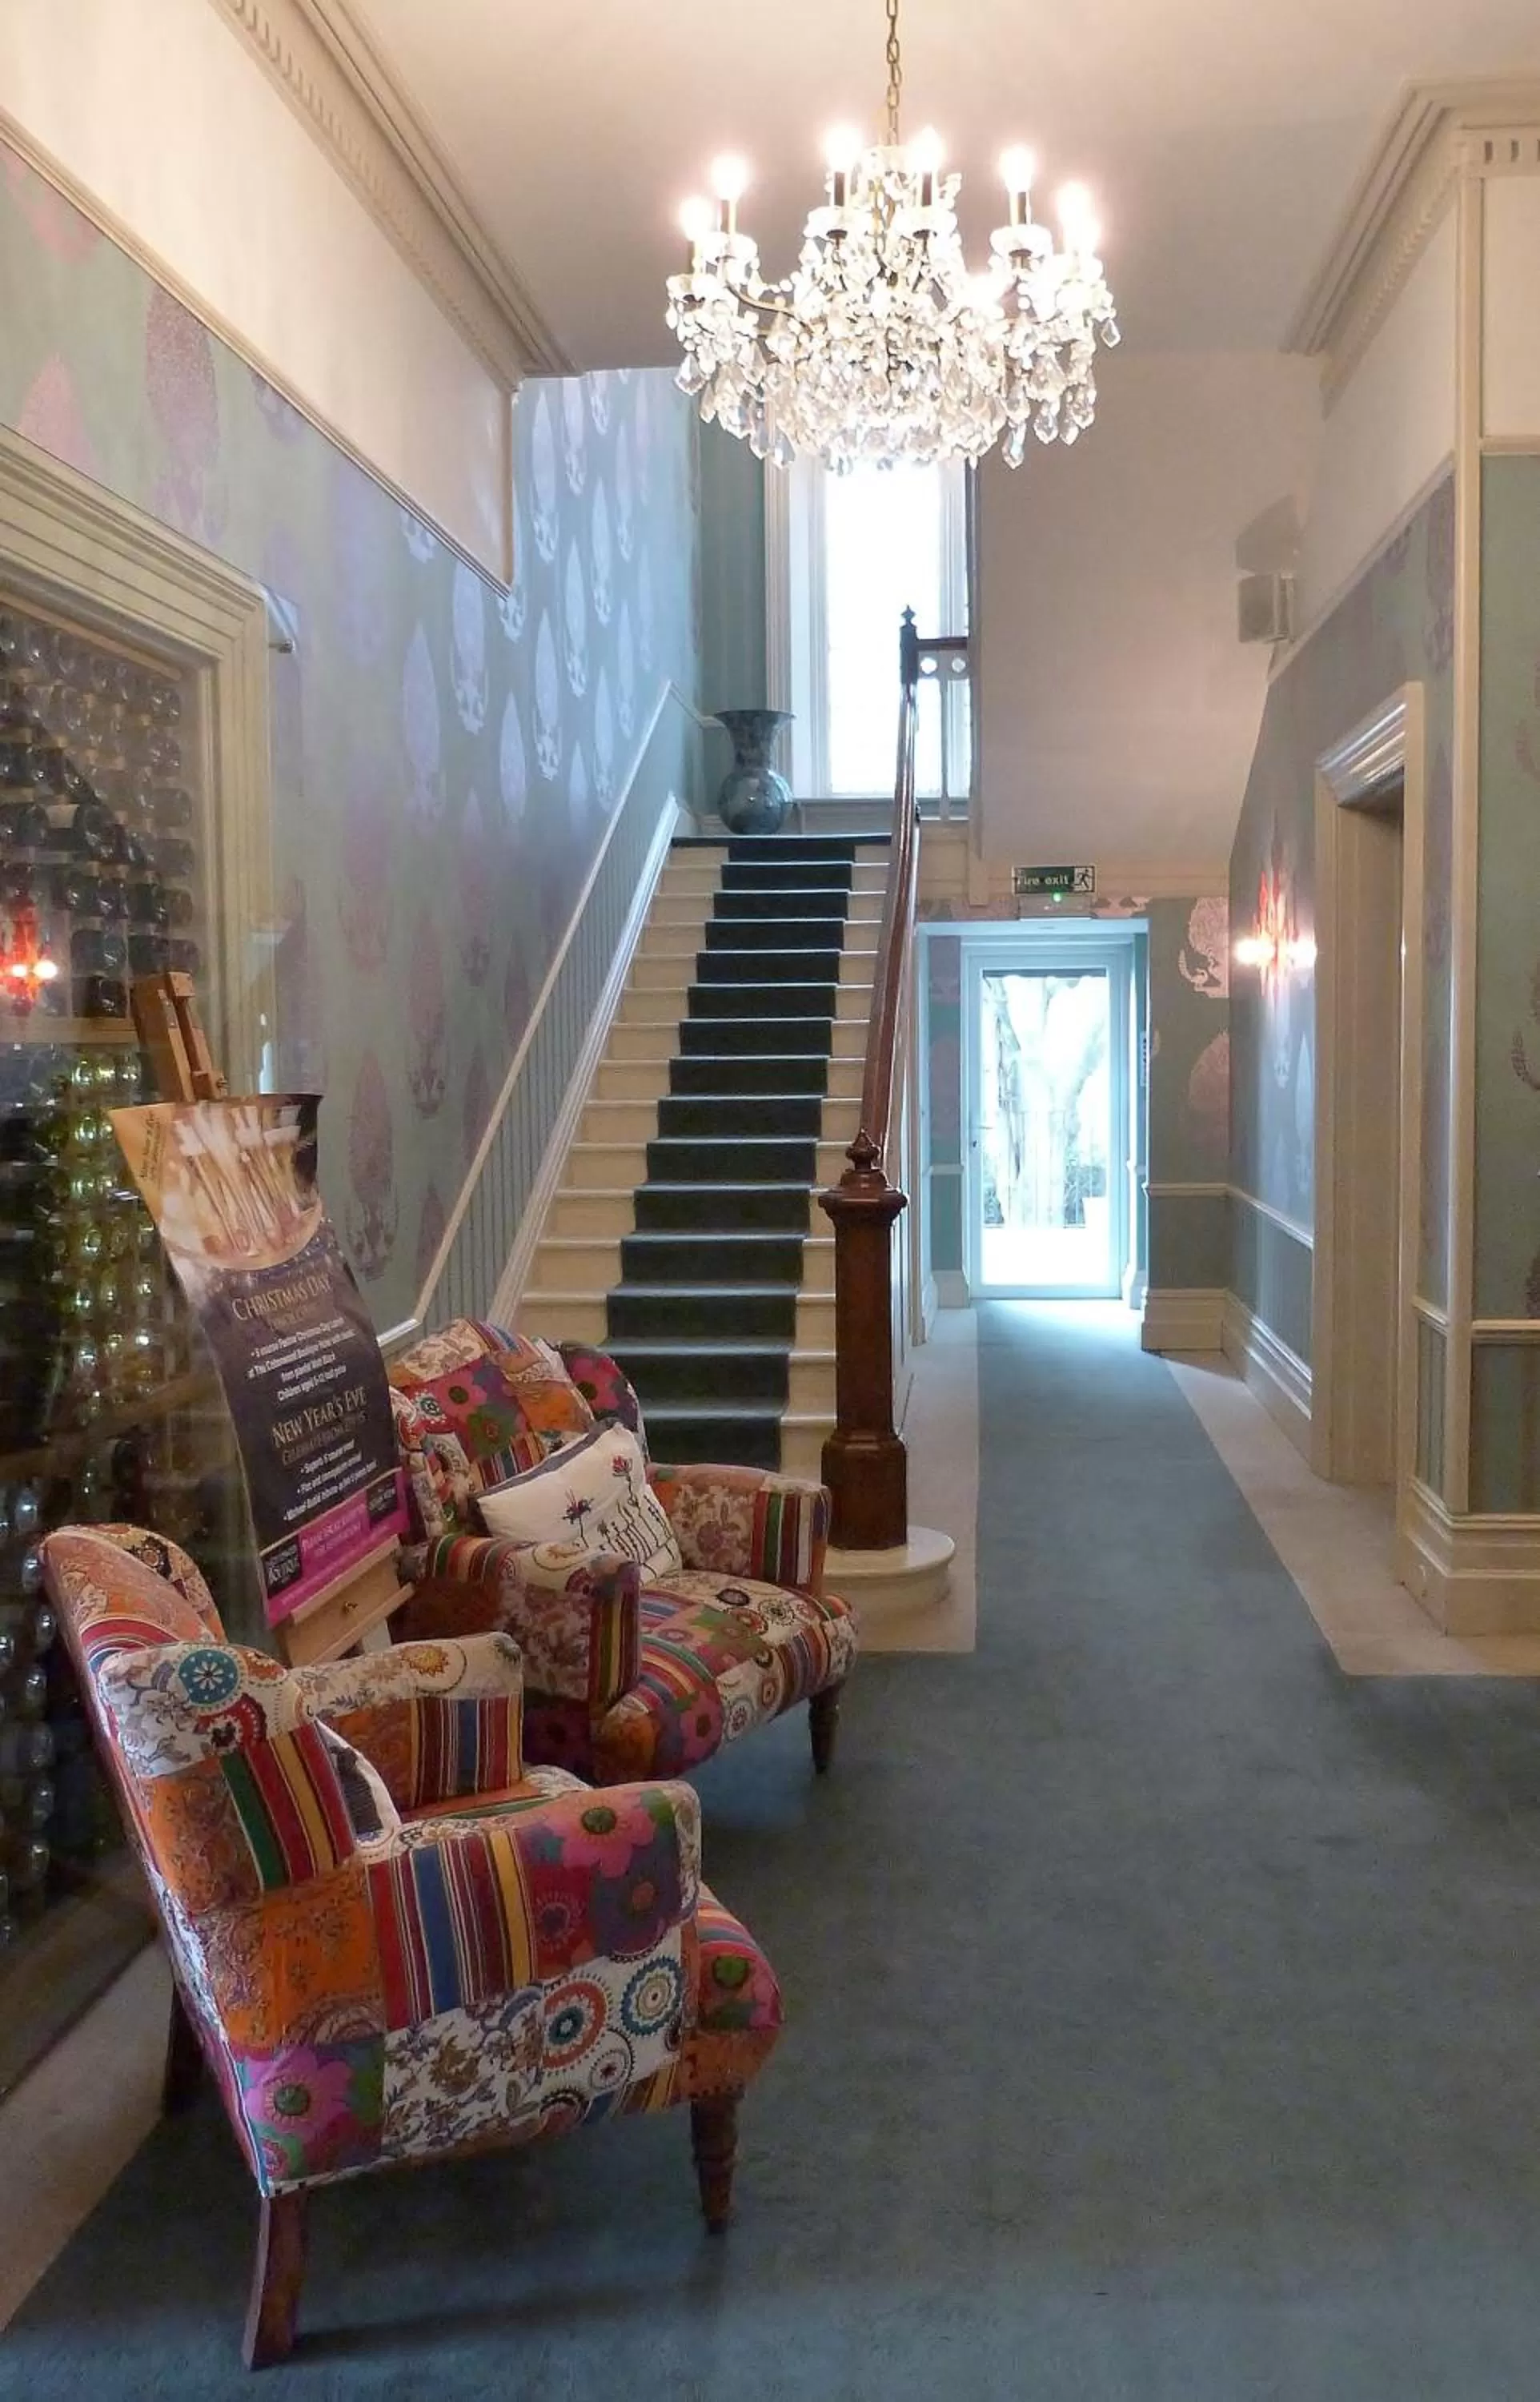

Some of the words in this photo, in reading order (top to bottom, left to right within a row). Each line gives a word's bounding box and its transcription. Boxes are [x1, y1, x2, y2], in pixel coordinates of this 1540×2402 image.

[1017, 876, 1040, 886] Fire
[1045, 874, 1069, 886] exit
[231, 1281, 308, 1321] CHRISTMAS
[306, 1273, 333, 1296] DAY
[272, 1415, 303, 1449] NEW
[303, 1394, 344, 1432] YEAR'S
[343, 1386, 368, 1412] EVE
